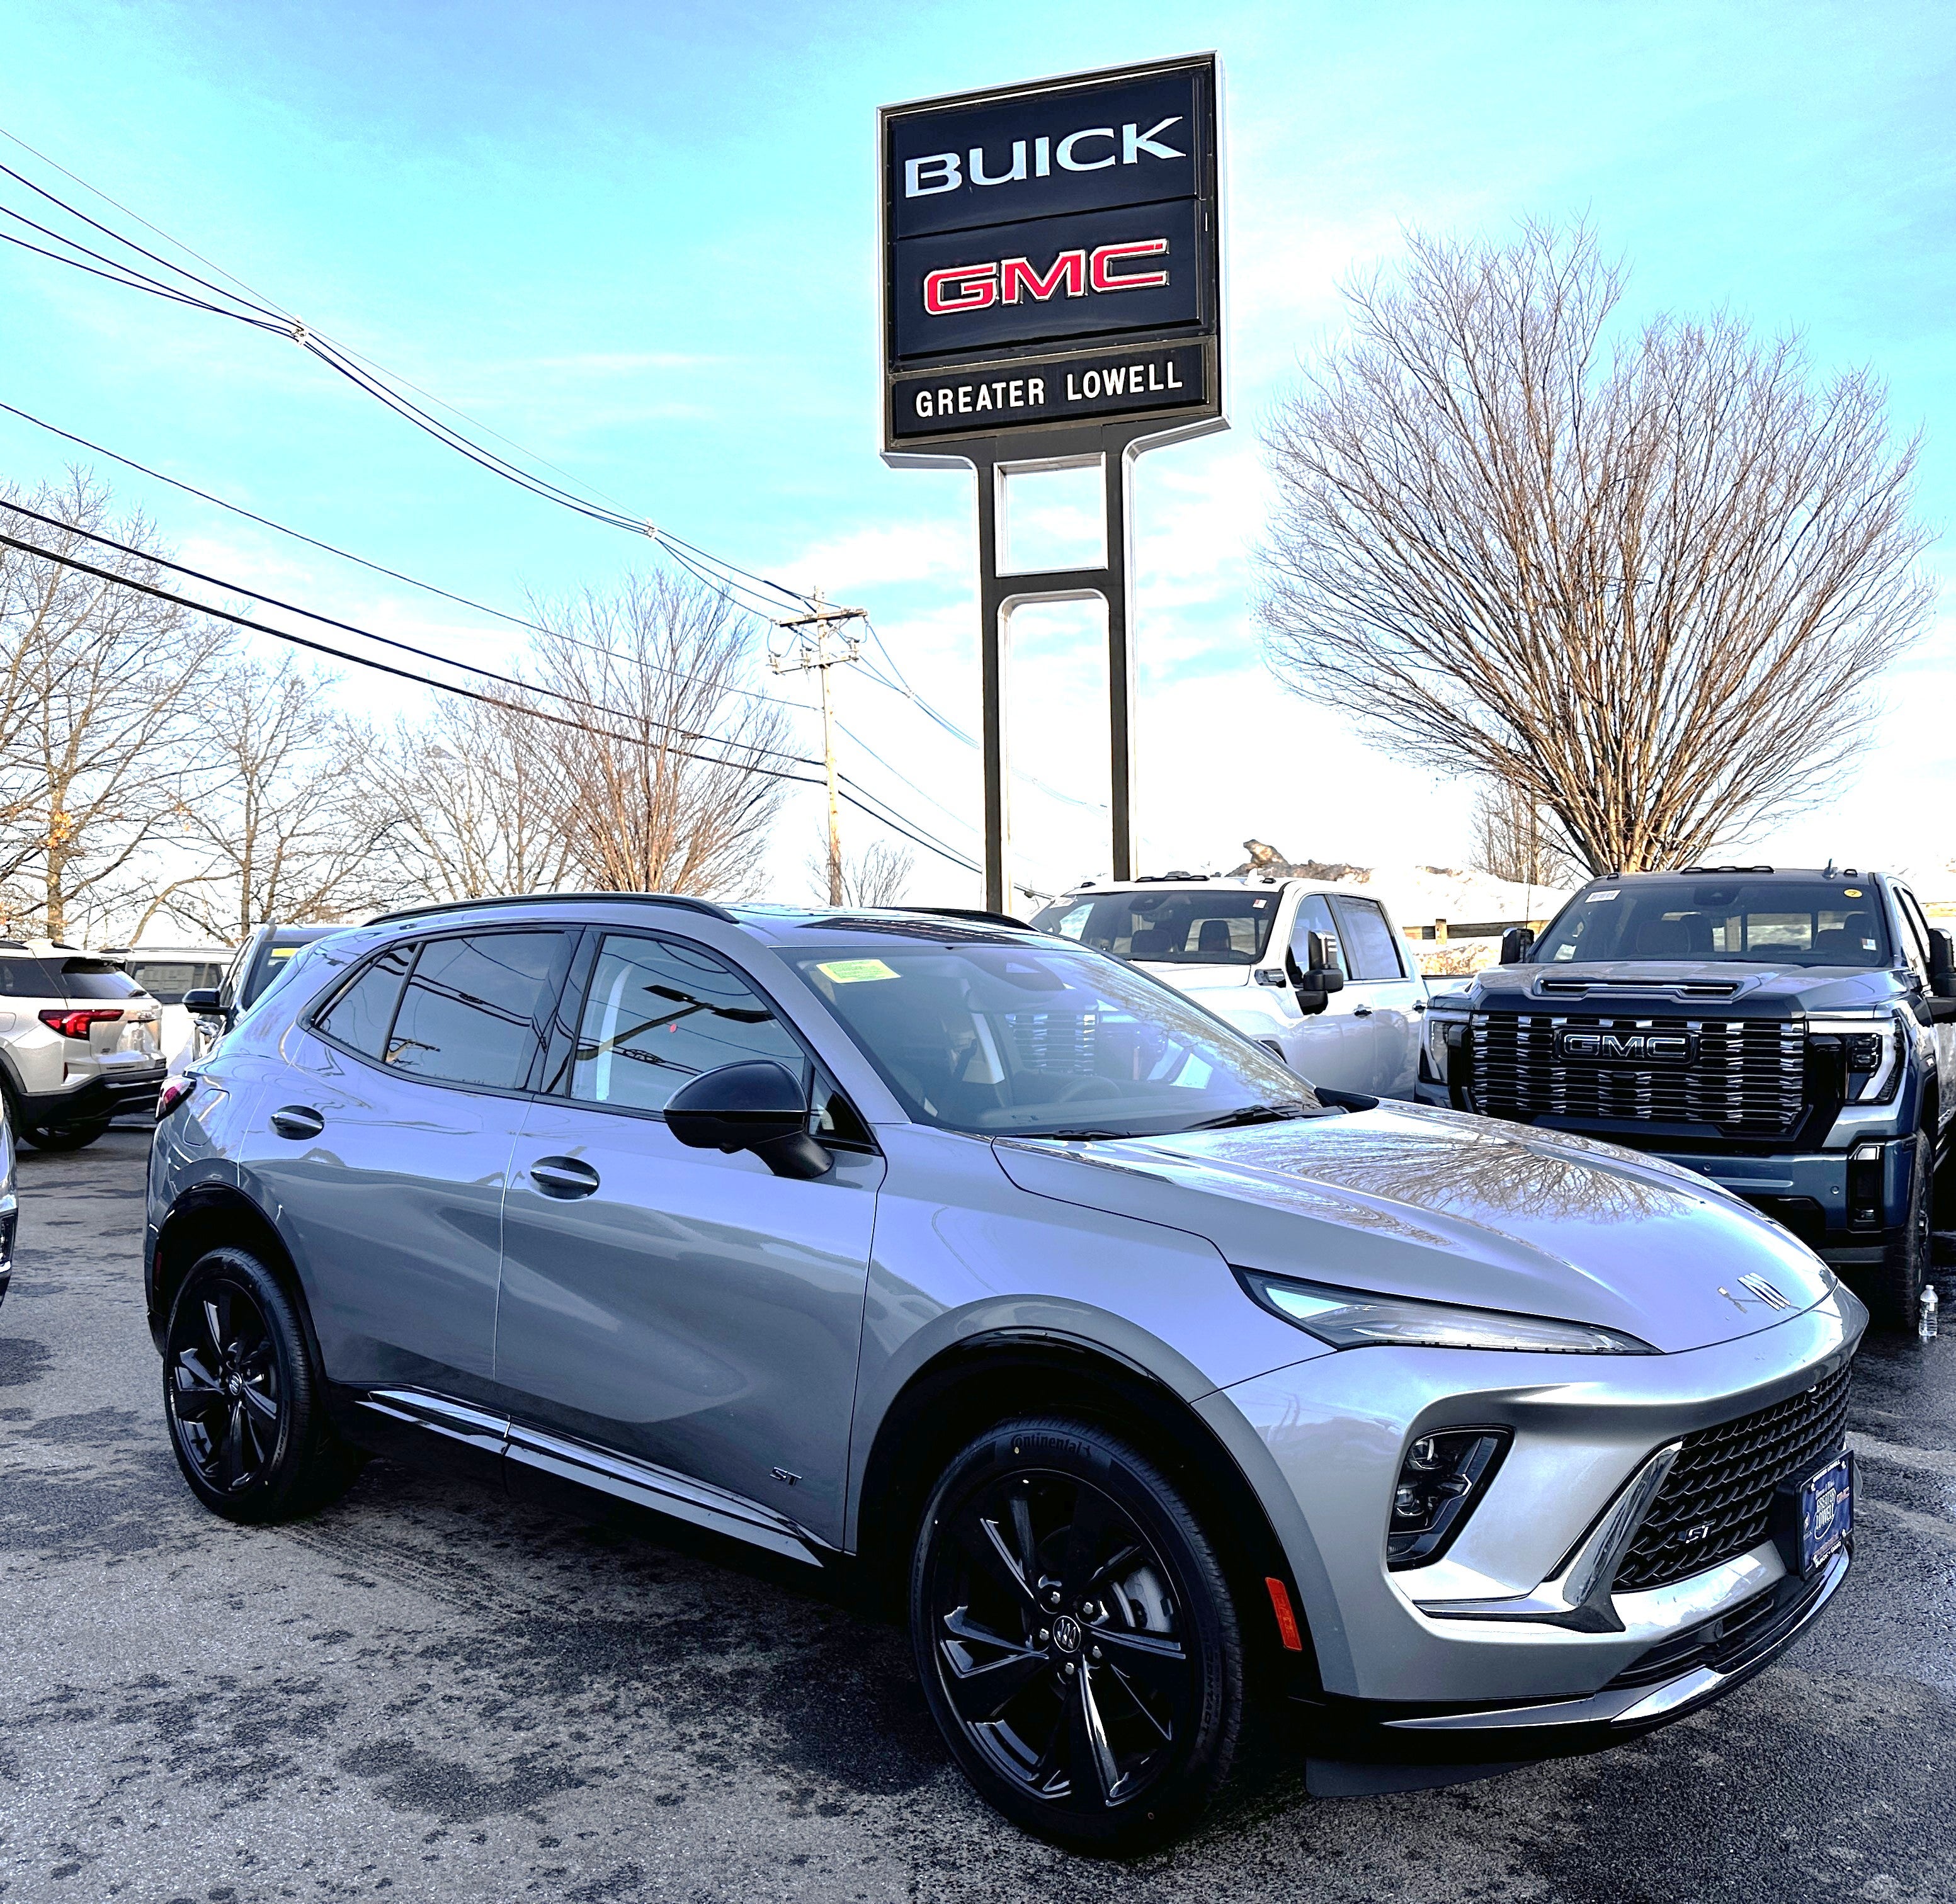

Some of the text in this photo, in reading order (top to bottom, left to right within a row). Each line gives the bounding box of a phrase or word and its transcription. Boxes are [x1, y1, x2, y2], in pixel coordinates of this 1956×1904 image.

[905, 116, 1186, 198] BUICK
[923, 238, 1169, 315] GMC
[915, 361, 1183, 418] GREATER LOWELL
[1564, 1034, 1686, 1058] GMC
[1010, 1432, 1083, 1455] Continental
[769, 1466, 803, 1487] ST
